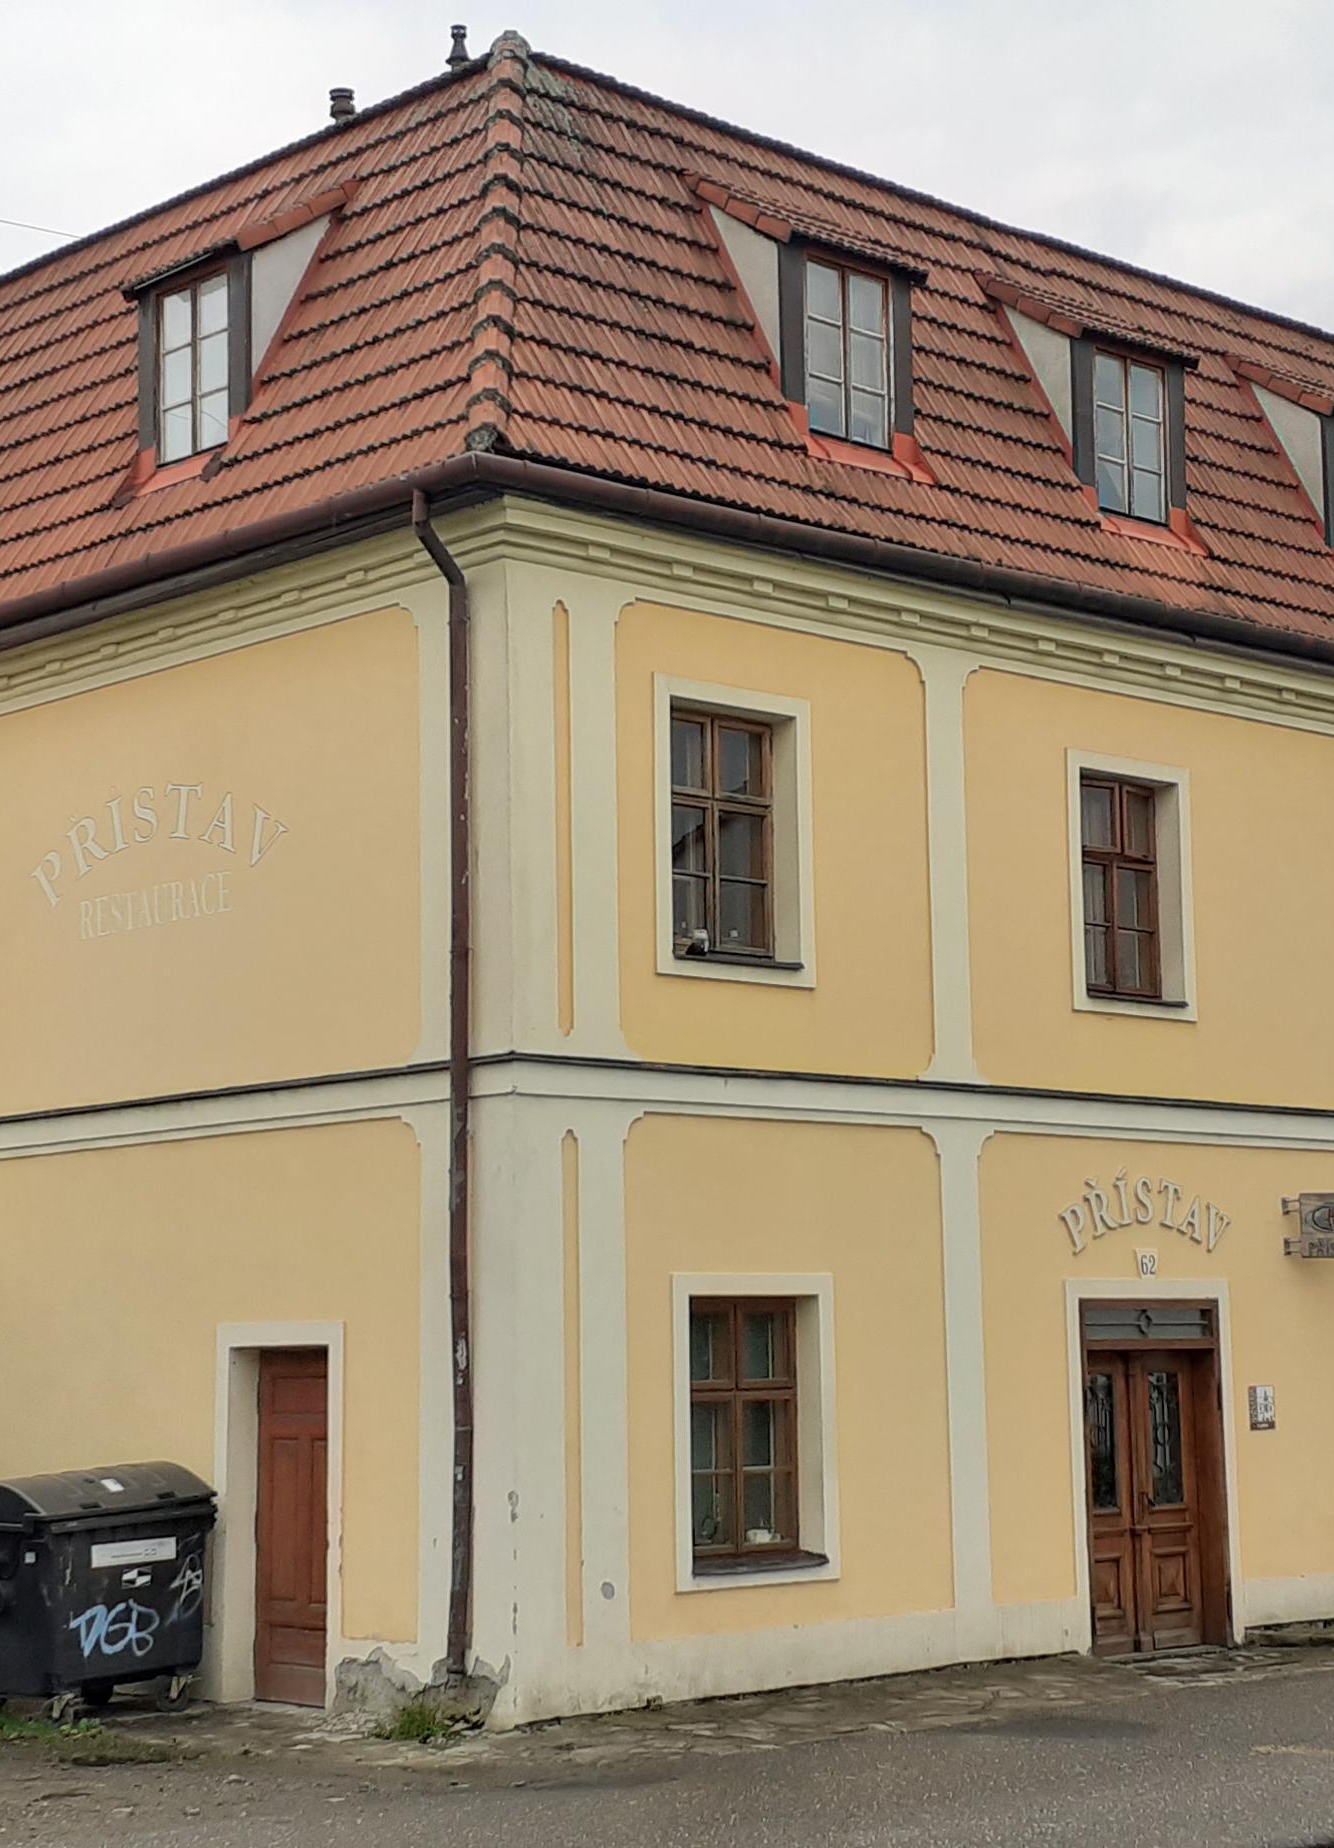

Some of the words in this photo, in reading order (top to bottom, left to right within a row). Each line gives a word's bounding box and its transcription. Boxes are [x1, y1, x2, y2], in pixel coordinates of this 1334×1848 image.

[79, 871, 234, 940] RESTAURACE
[1060, 1168, 1230, 1255] PŘÍSTAV
[1140, 1254, 1156, 1275] 62
